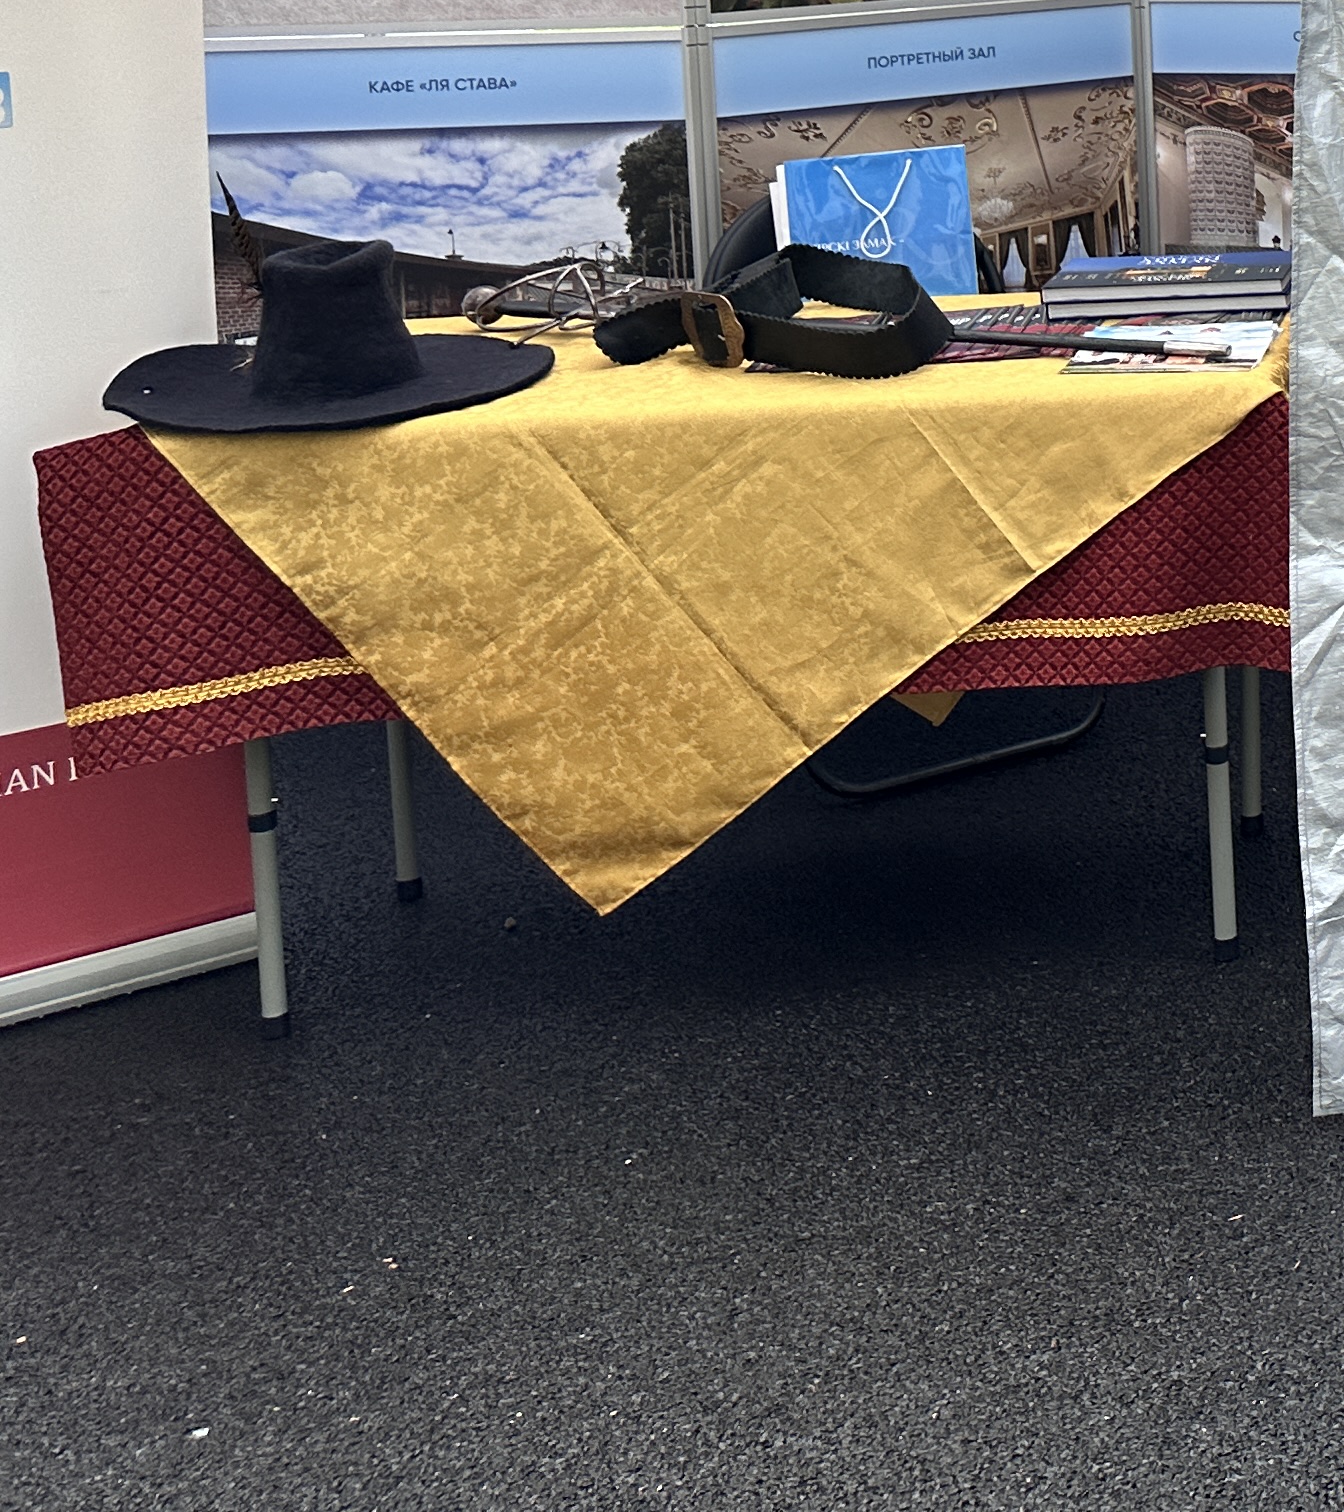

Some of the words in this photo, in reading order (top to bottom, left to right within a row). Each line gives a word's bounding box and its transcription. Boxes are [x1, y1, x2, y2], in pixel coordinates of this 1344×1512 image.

[867, 46, 965, 69] ПОРТРЕТНЫЙ
[967, 45, 996, 60] ЗАЛ
[368, 79, 415, 94] КАФЕ
[419, 78, 450, 92] «ЛЯ
[454, 76, 518, 92] СТАВА»
[0, 760, 55, 797] AN
